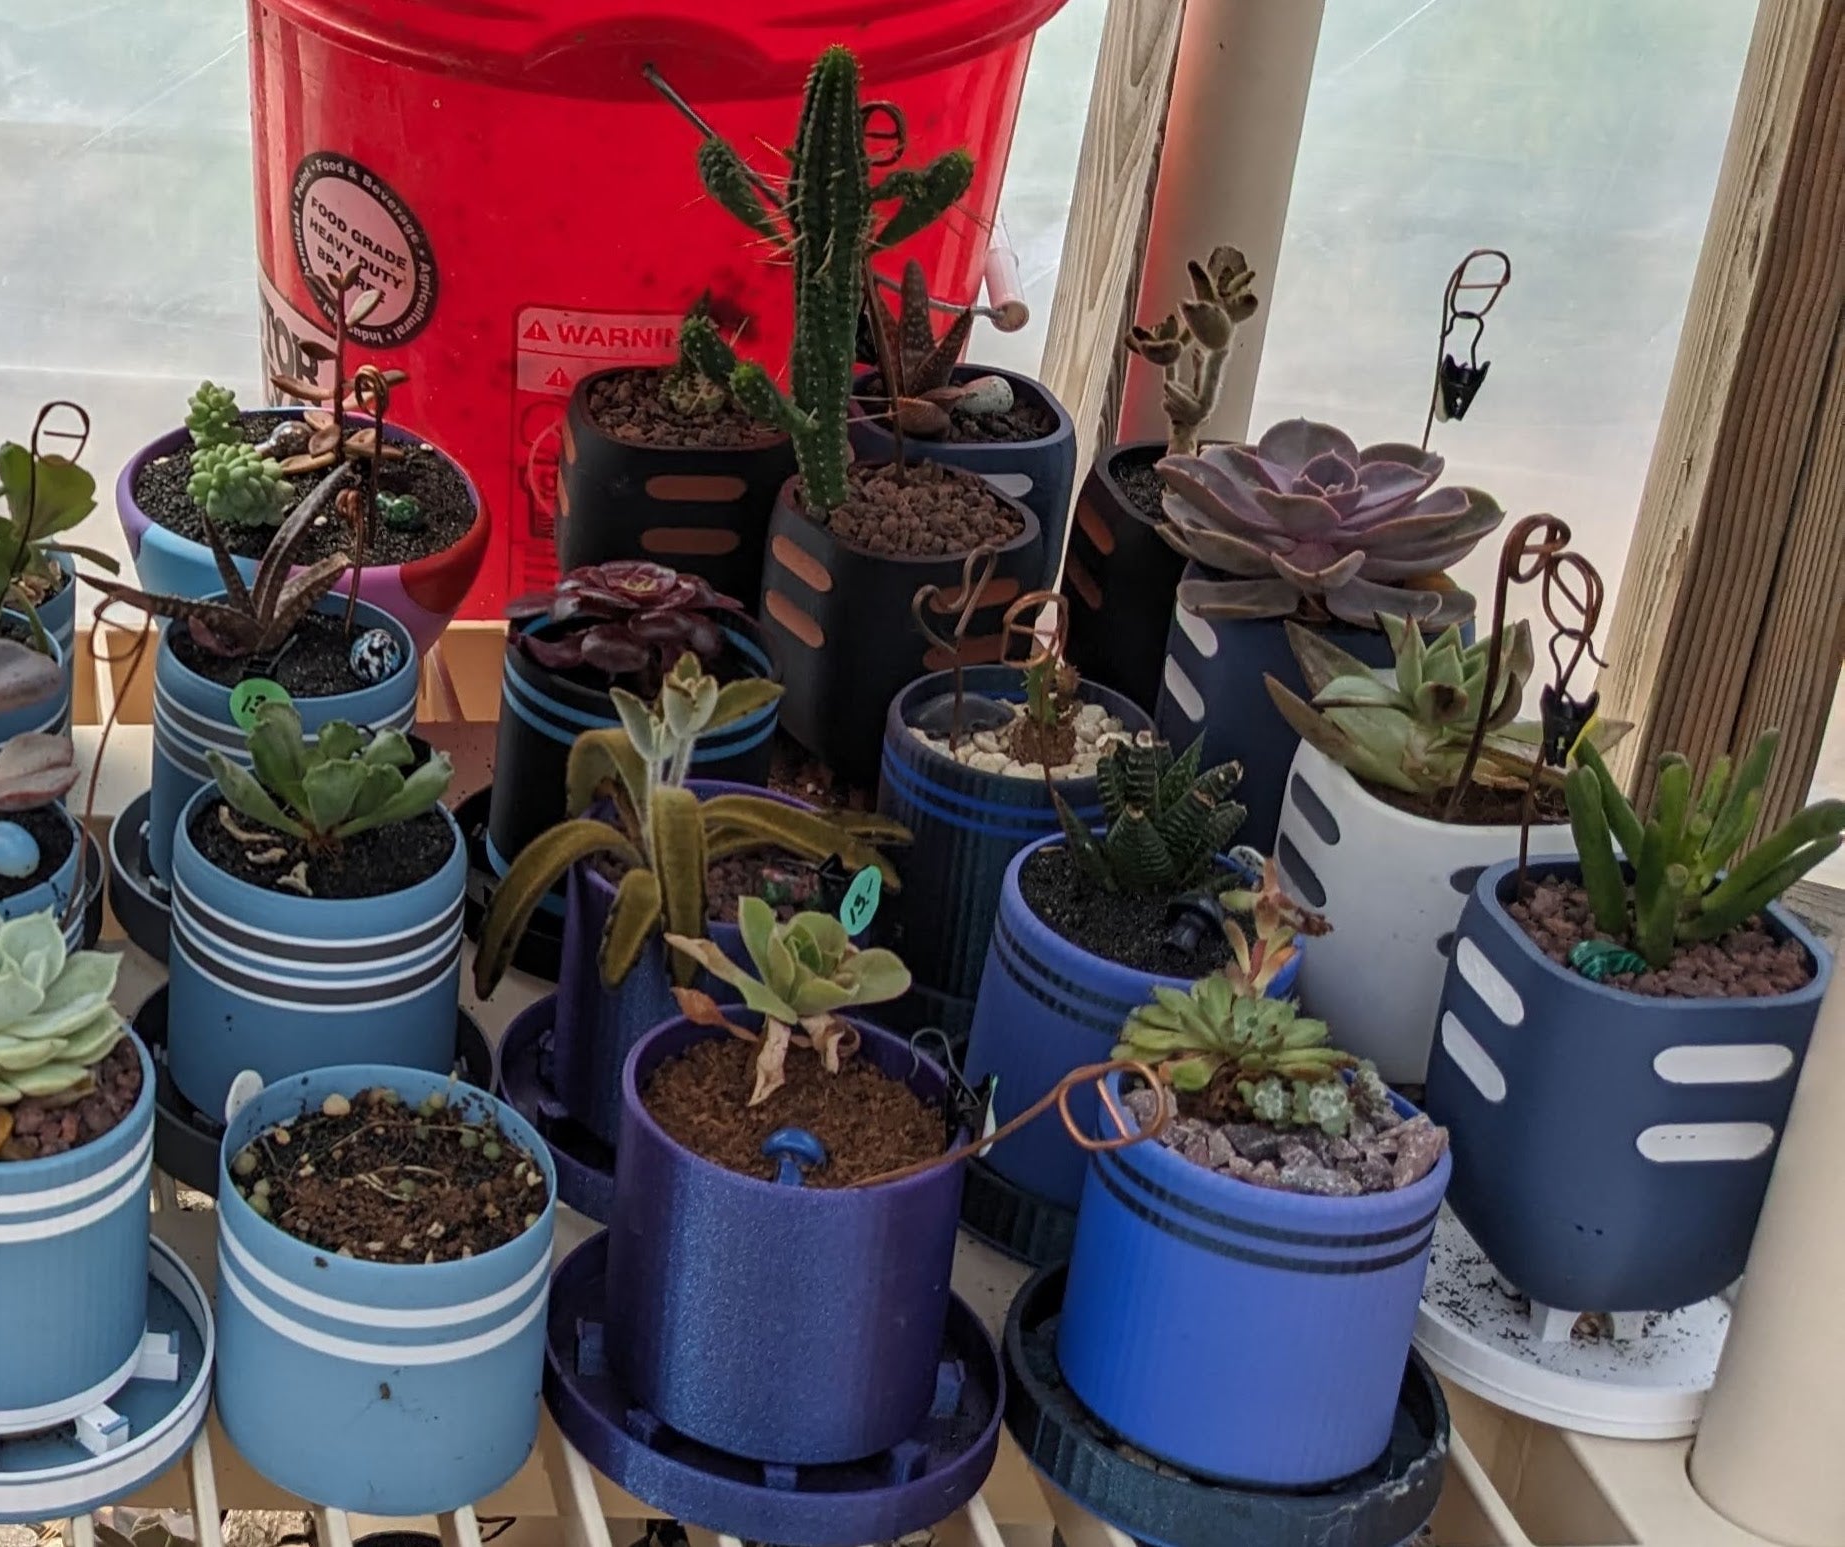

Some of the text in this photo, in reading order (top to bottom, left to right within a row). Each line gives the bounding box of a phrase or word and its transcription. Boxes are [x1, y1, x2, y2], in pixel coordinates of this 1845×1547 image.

[294, 166, 312, 199] Paint
[315, 159, 419, 244] Food & Beverage
[309, 217, 403, 290] HEAVY DUTY
[311, 196, 407, 271] FOOD GRADE
[317, 246, 342, 274] BPA
[393, 261, 433, 340] Agricultural
